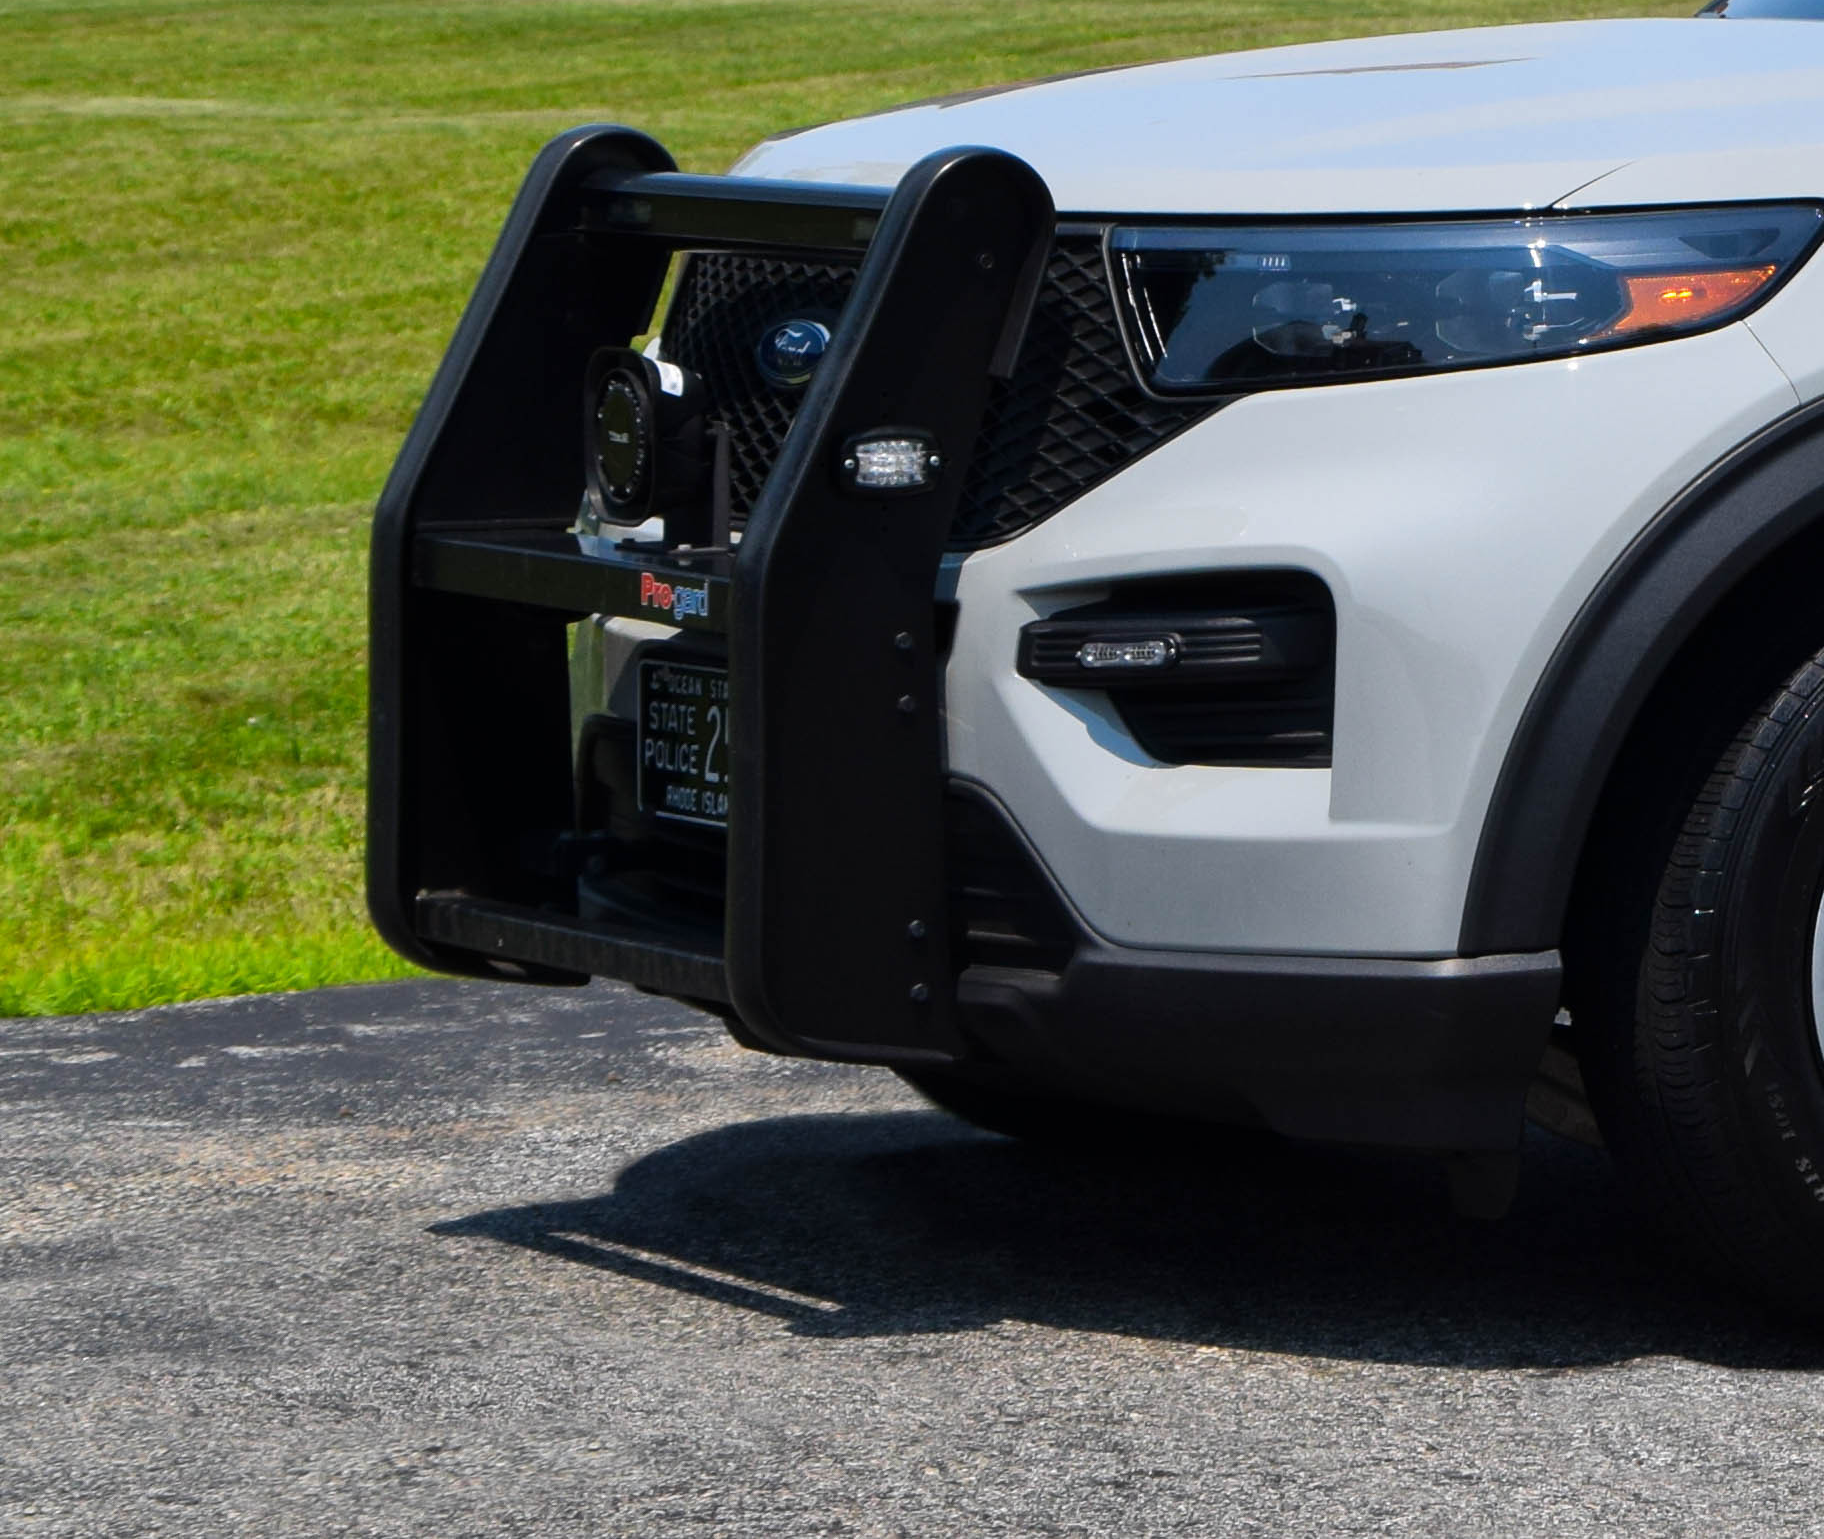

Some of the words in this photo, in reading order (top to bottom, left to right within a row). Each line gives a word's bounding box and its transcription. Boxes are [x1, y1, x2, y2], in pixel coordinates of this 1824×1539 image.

[640, 571, 709, 621] Pro-gard
[668, 674, 703, 697] OCEAN
[649, 701, 697, 736] STATE
[645, 738, 699, 775] POLICE
[705, 705, 728, 783] 2
[666, 784, 698, 811] RHODE
